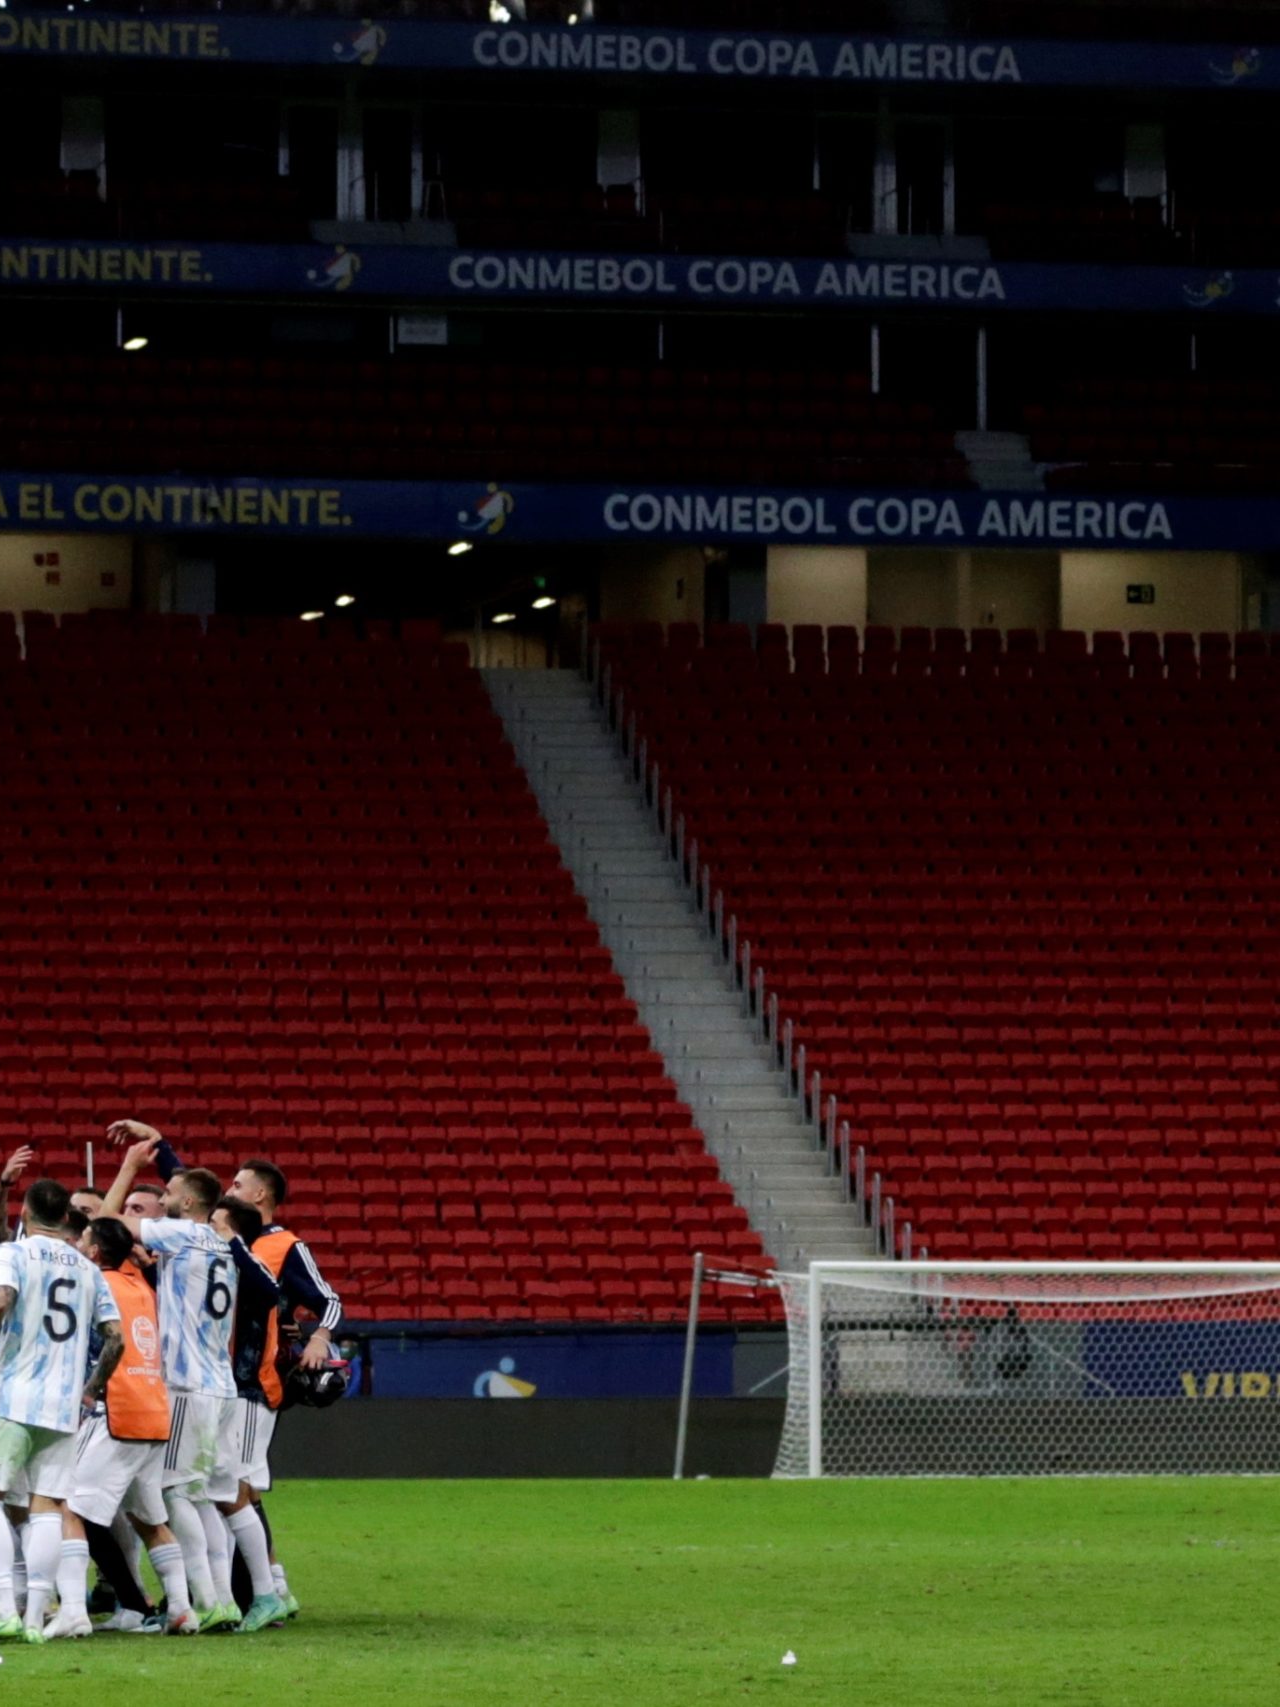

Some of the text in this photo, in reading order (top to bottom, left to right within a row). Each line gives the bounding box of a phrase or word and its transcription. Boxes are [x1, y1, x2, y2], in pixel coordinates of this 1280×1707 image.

[473, 31, 1020, 82] CONMEBOL COPA AMERICA
[449, 256, 1004, 298] CONMEBOL COPA AMERICA
[20, 484, 63, 518] EL
[74, 485, 352, 525] CONTINENTE.
[604, 494, 1172, 538] CONMEBOL COPA AMERICA
[43, 1278, 77, 1342] 5
[206, 1258, 231, 1320] 6
[1182, 1372, 1280, 1398] VIB
